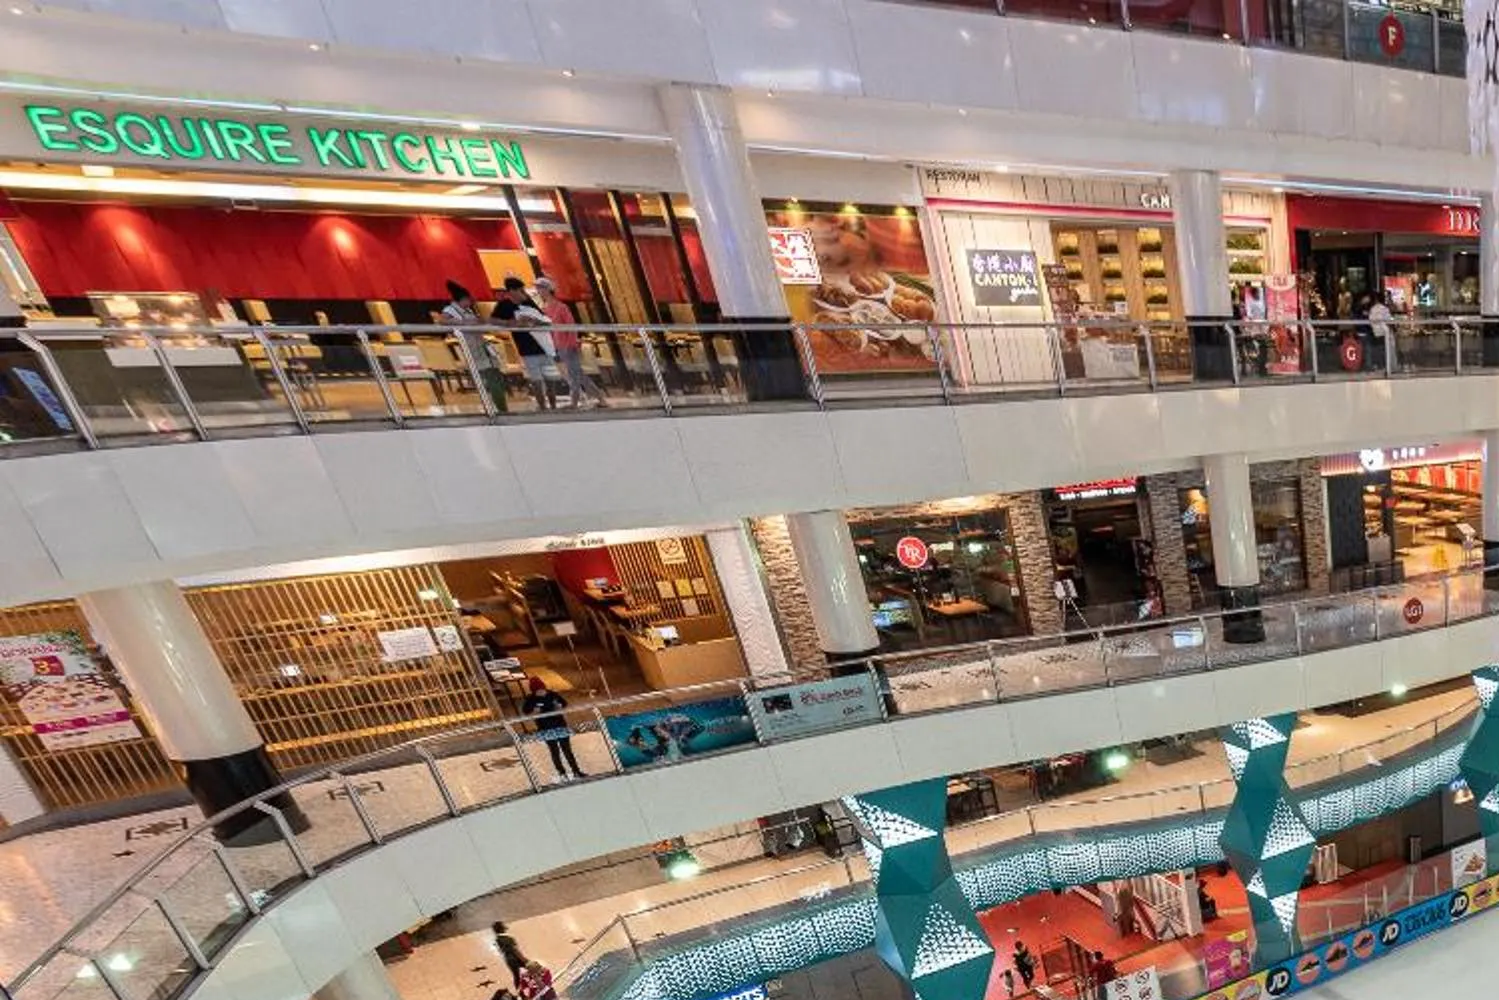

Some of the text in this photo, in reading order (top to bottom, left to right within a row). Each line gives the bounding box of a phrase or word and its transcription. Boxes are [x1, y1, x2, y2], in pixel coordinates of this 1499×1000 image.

[24, 105, 531, 179] ESQUIRE KITCHEN
[1346, 346, 1356, 360] G
